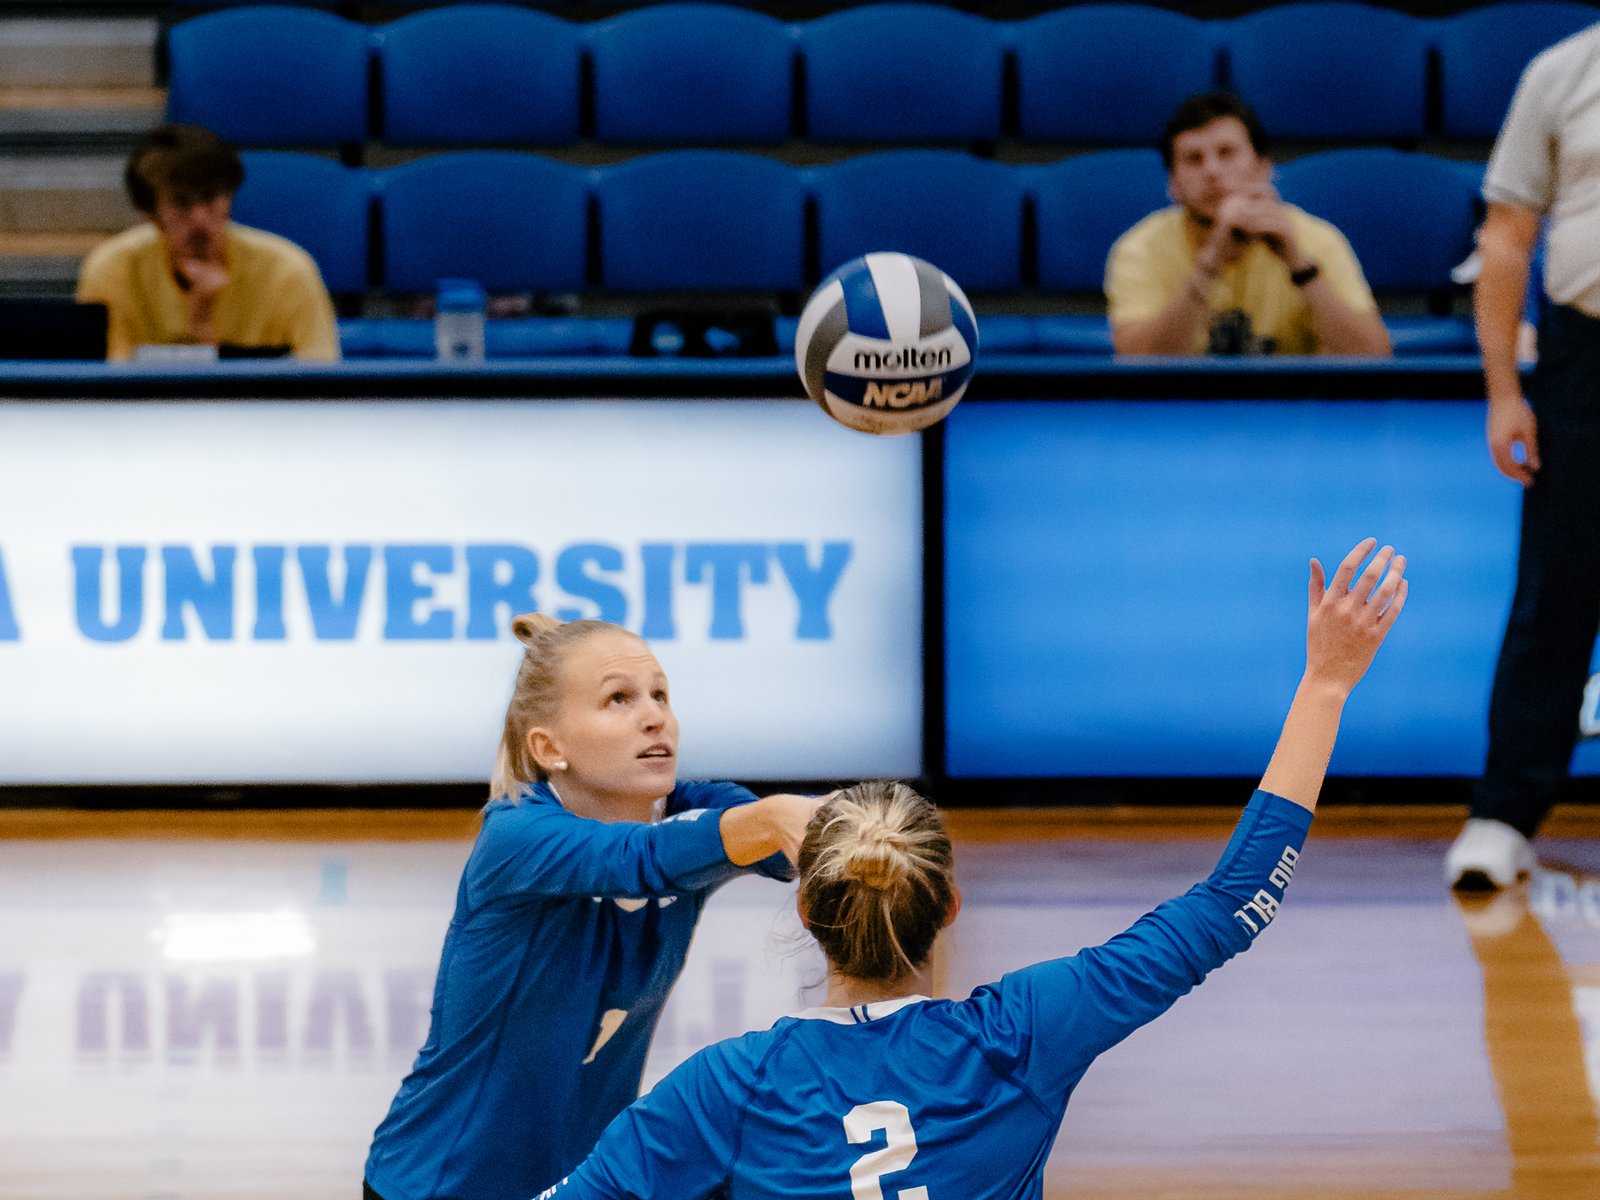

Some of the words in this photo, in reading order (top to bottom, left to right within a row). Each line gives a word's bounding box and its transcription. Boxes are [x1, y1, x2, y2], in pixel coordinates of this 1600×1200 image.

[854, 346, 952, 369] molten
[862, 377, 943, 408] NCAA
[70, 543, 853, 643] UNIVERSITY
[1268, 845, 1300, 889] BIG
